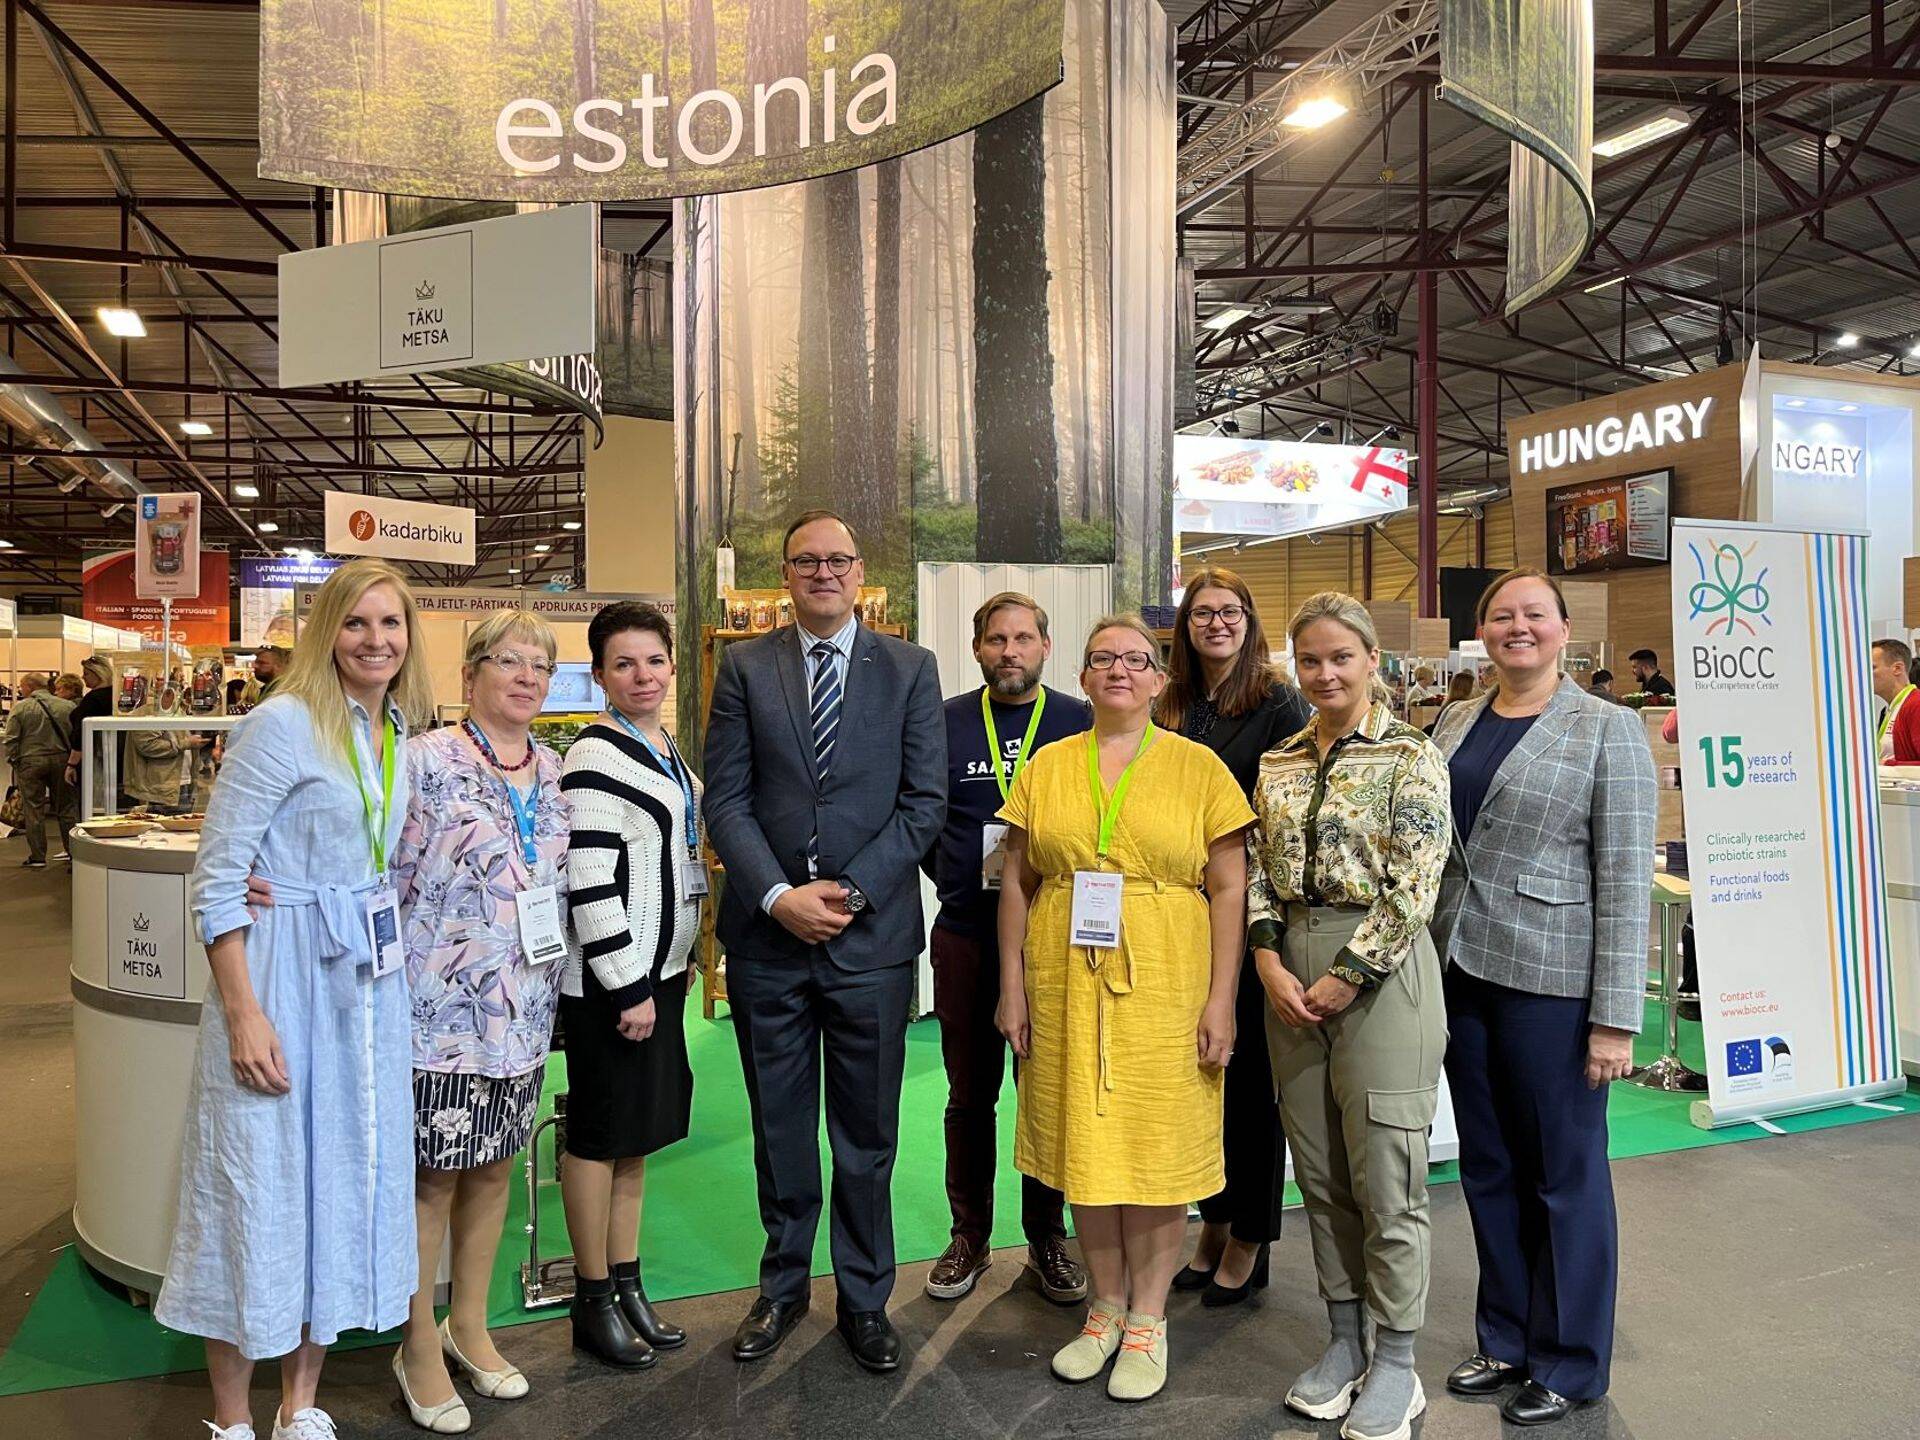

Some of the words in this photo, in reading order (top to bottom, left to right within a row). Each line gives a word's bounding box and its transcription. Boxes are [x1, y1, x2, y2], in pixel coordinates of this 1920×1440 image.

[495, 35, 897, 172] estonia
[408, 307, 443, 326] TÄKU
[402, 328, 449, 348] METSA
[1519, 396, 1714, 474] HUNGARY
[1776, 443, 1862, 474] NGARY
[379, 519, 463, 544] kadarbiku
[532, 600, 588, 612] APDRUKAS
[1693, 645, 1776, 679] BioCC
[1699, 736, 1745, 788] 15
[1747, 753, 1777, 768] years
[1780, 751, 1792, 765] of
[1749, 768, 1797, 783] research
[1707, 832, 1752, 846] Clinically
[1754, 830, 1806, 842] researched
[1708, 849, 1754, 864] probiotic
[1756, 847, 1787, 860] strains
[1710, 871, 1761, 886] Functional
[1763, 870, 1790, 883] foods
[1711, 889, 1731, 903] and
[1734, 888, 1763, 901] drinks
[127, 937, 157, 957] TÄKU
[123, 959, 162, 979] METSA
[1720, 990, 1753, 1002] Contact
[1721, 1002, 1779, 1018] www.biocc.eu
